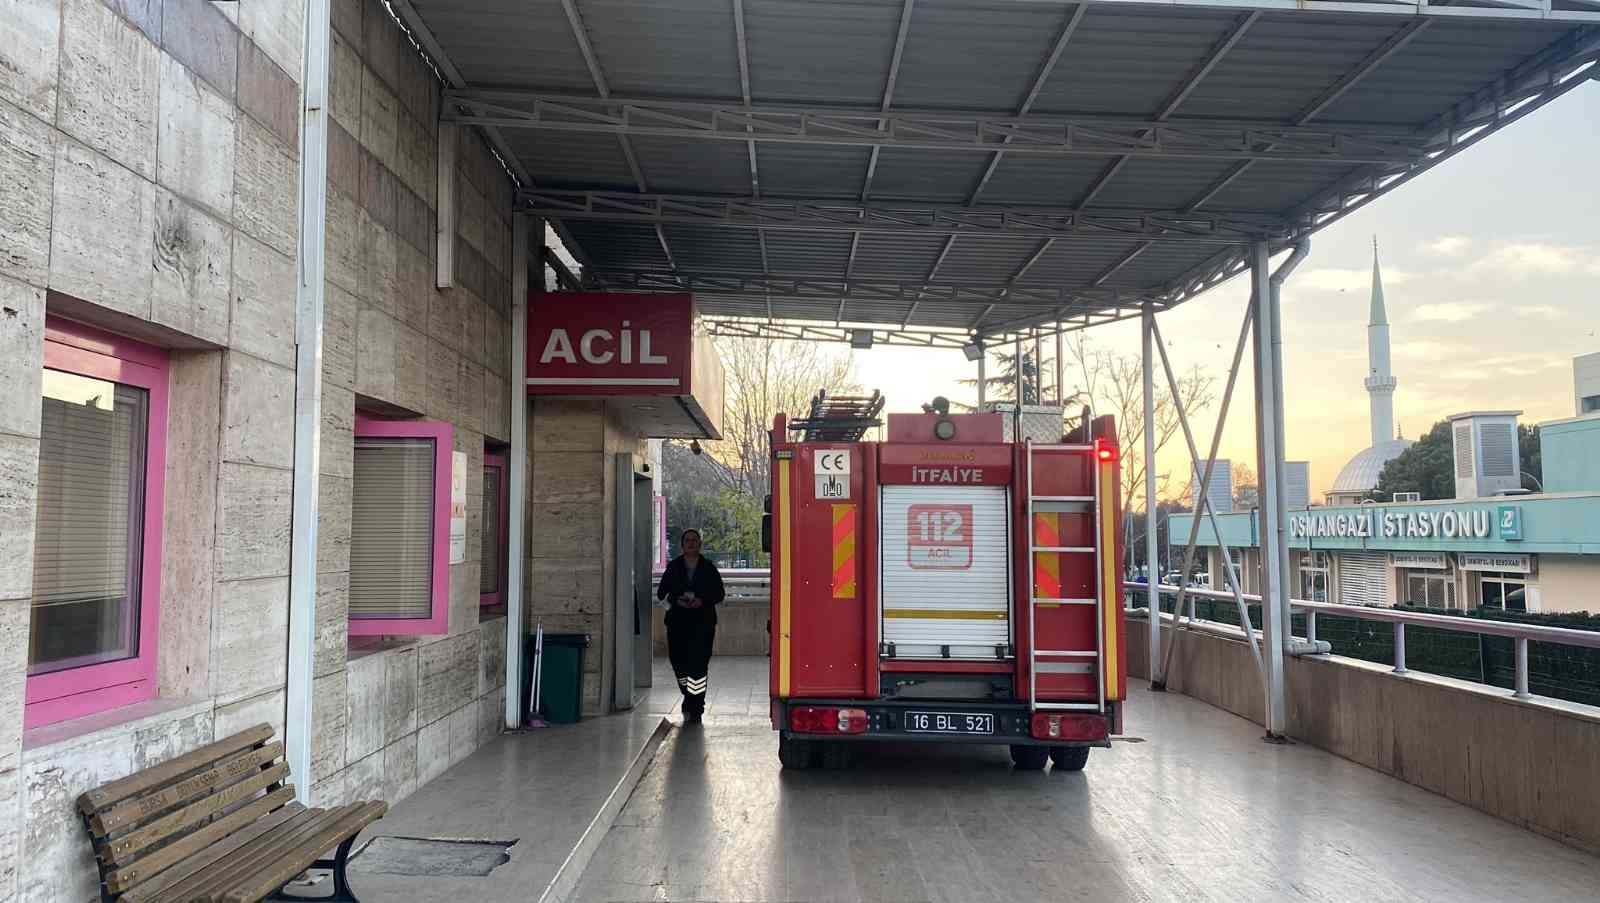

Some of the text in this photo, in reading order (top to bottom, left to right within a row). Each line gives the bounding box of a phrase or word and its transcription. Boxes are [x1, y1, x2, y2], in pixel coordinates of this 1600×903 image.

[539, 320, 668, 365] ACİL
[911, 466, 984, 483] İTFAİYE
[916, 511, 963, 542] 112
[1290, 508, 1373, 537] OSMANGAZİ
[1379, 507, 1490, 537] İSTASYONU
[913, 714, 991, 731] 16 BL 521
